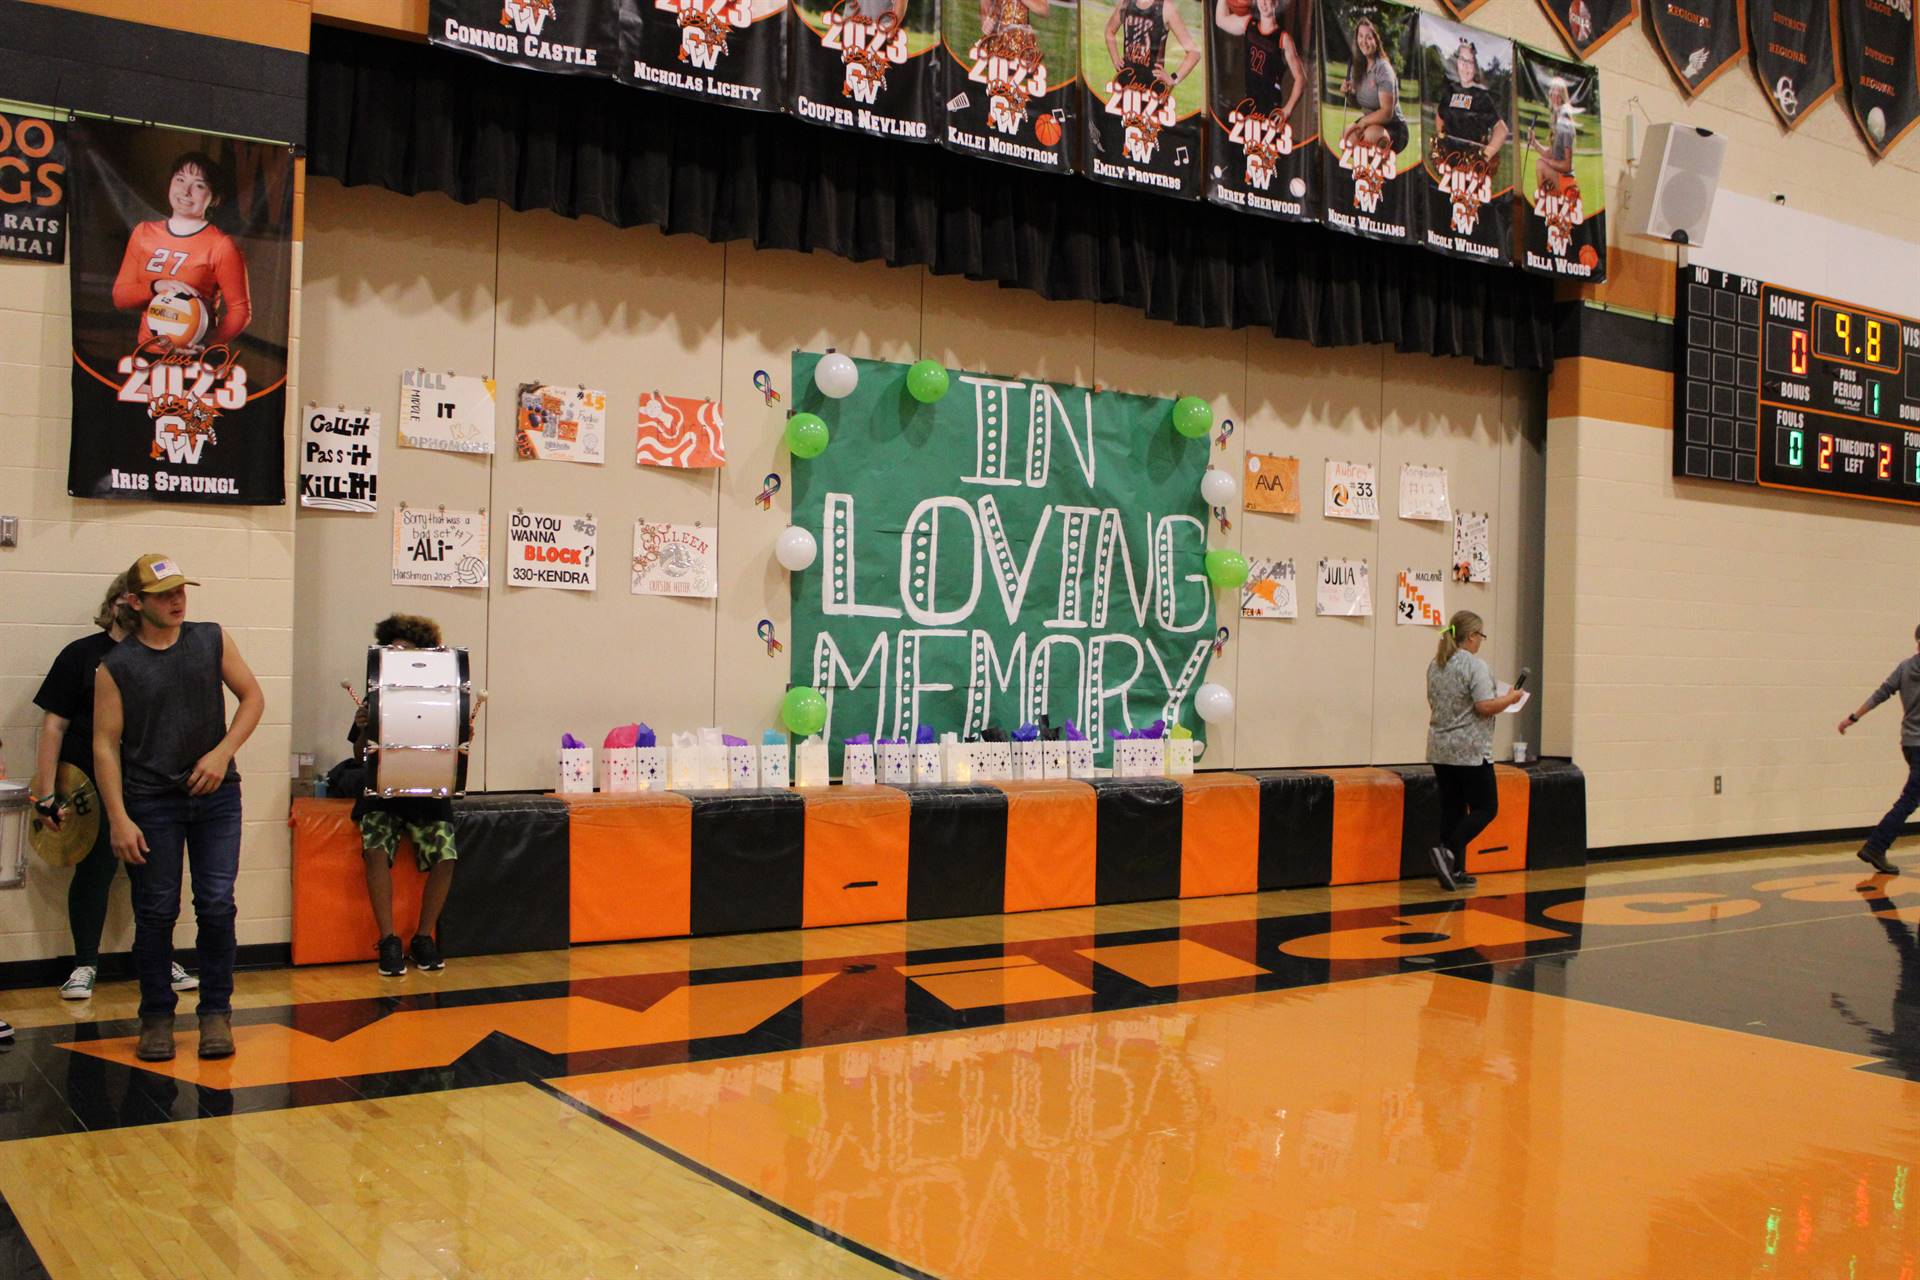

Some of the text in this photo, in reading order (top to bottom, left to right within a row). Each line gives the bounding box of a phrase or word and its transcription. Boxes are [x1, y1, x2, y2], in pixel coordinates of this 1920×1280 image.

[4, 213, 60, 234] RATS
[145, 248, 190, 276] 27
[1695, 266, 1758, 296] NO F PTS
[1769, 295, 1805, 322] HOME
[1791, 330, 1807, 375] 0
[117, 355, 248, 410] 2023
[1781, 382, 1810, 401] BONUS
[1833, 381, 1863, 400] PERIOD
[437, 402, 455, 419] IT
[1873, 383, 1880, 416] 1
[1777, 410, 1804, 429] FOULS
[959, 376, 1095, 488] IN
[1789, 430, 1803, 466] 0
[1819, 435, 1833, 470] 2
[1835, 438, 1875, 458] TIMEOUTS
[1844, 457, 1865, 474] LEFT
[1880, 444, 1892, 478] 2
[111, 469, 239, 495] IRIS SPRUNGL
[1255, 474, 1284, 492] AVA
[403, 511, 427, 529] Sorry
[512, 515, 561, 532] DO YOU
[511, 529, 556, 544] WANNA
[822, 492, 1210, 633] LOVING
[513, 568, 590, 584] 330-KENDRA
[1324, 566, 1356, 586] JULIA
[813, 628, 1214, 753] MEMORY
